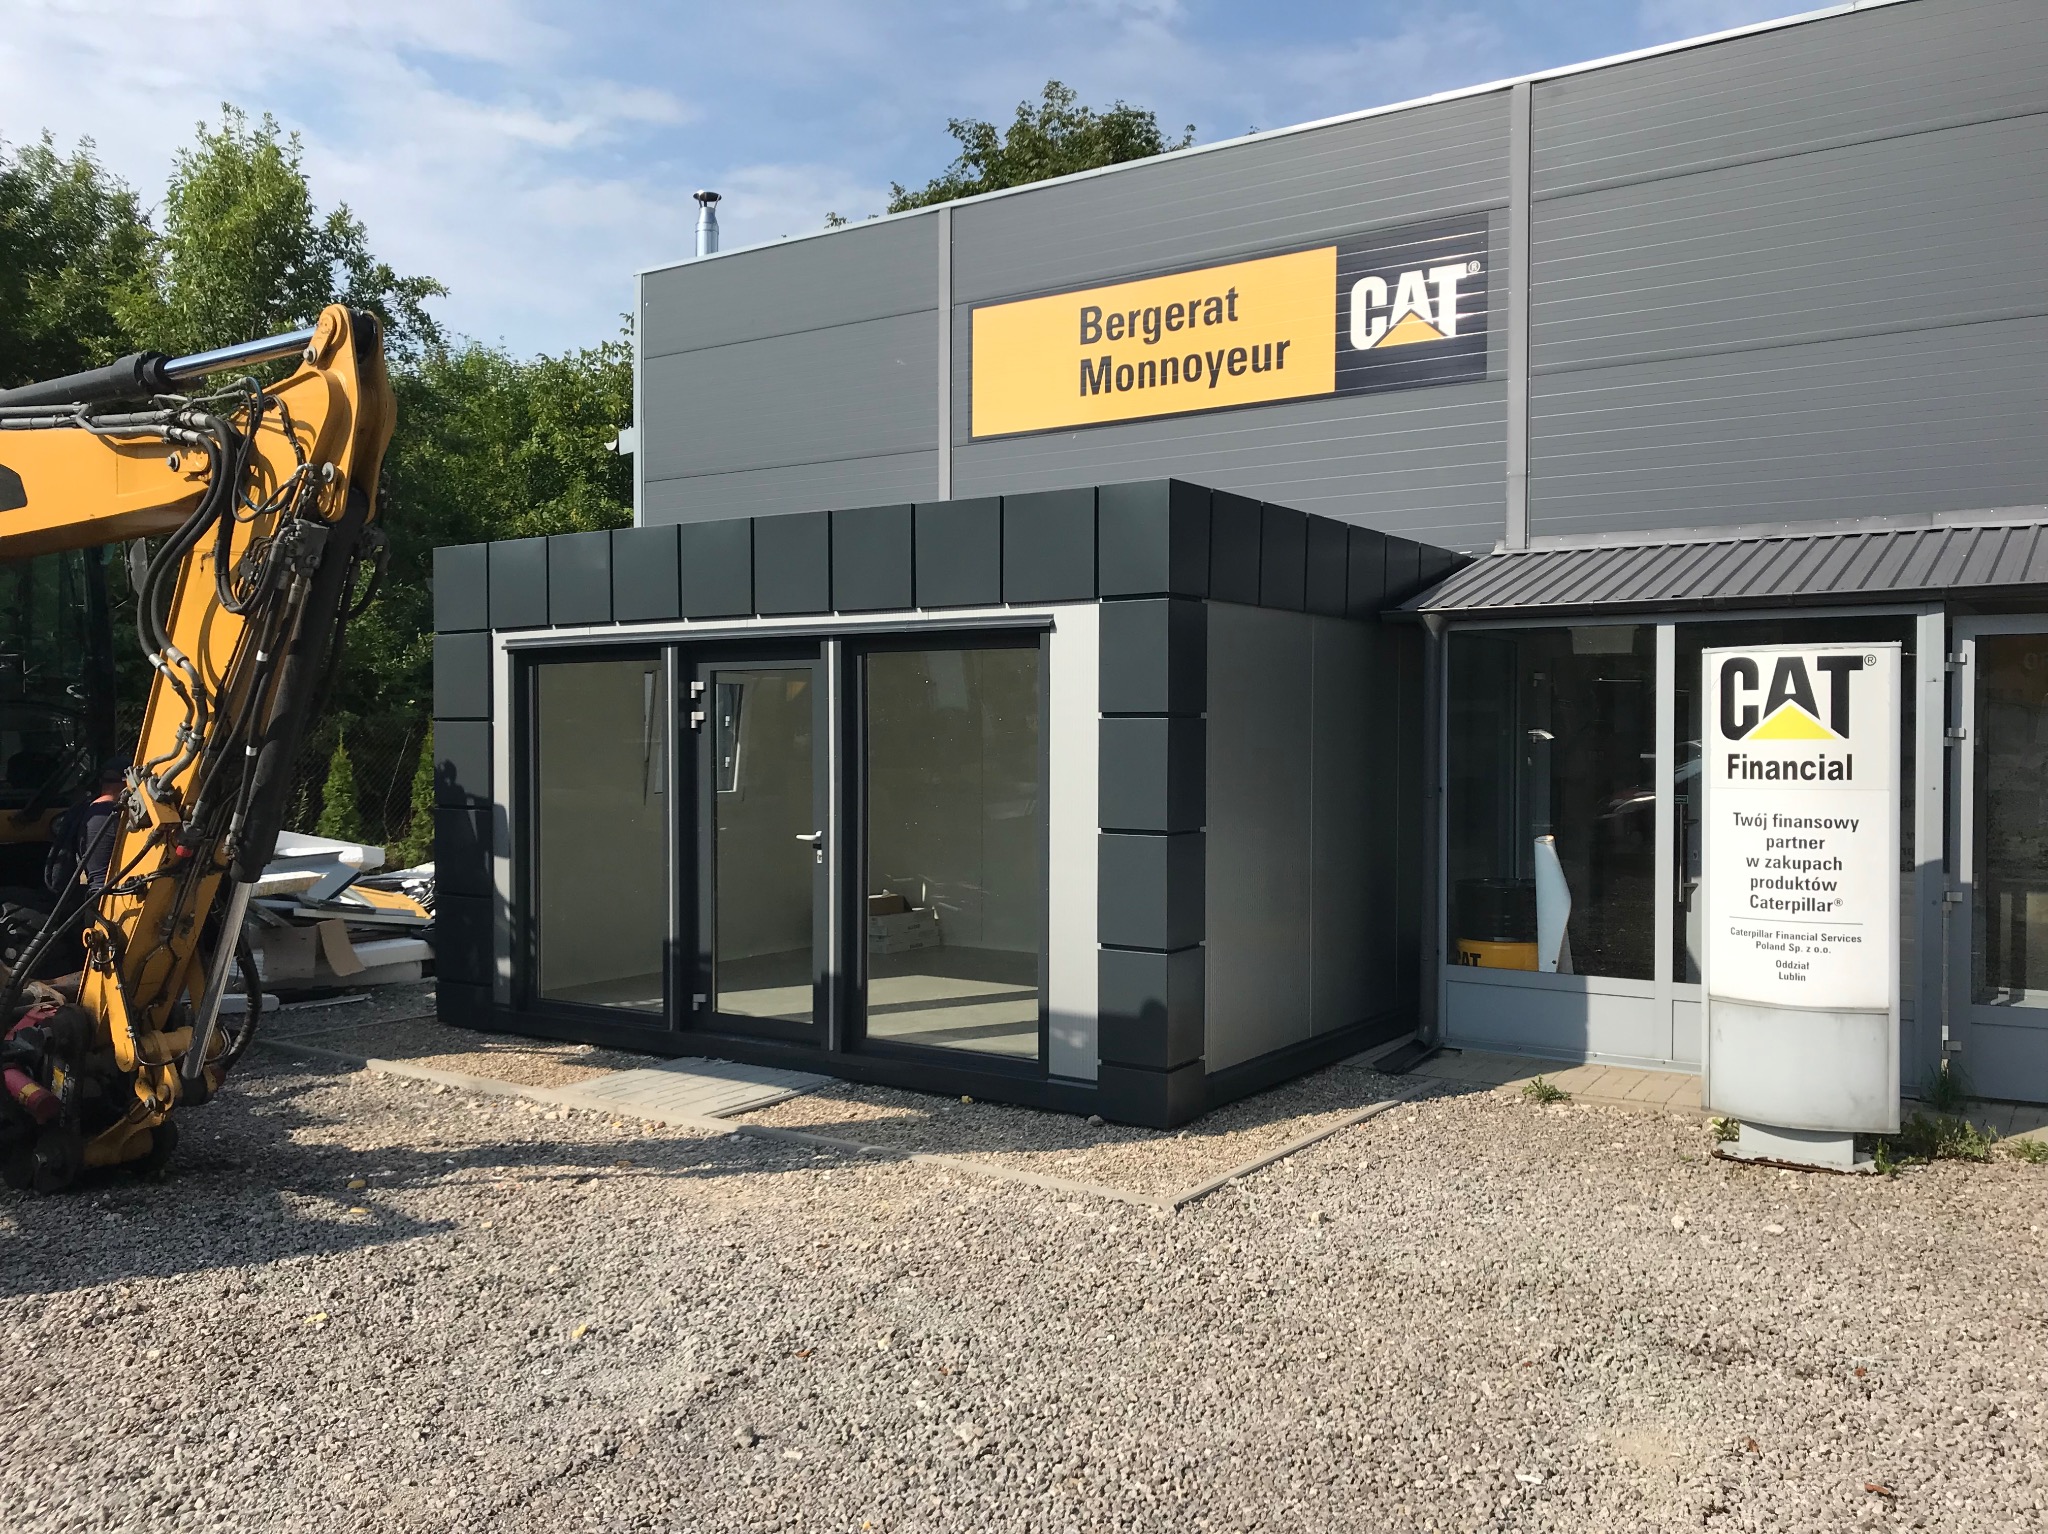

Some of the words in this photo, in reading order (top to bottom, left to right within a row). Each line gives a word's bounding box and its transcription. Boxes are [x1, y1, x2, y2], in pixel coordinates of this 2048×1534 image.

[1079, 286, 1239, 346] Bergerat
[1079, 339, 1291, 398] Monnoyeur
[1727, 753, 1853, 781] Financial
[1733, 812, 1768, 831] Twój
[1772, 813, 1860, 833] finansowy
[1766, 836, 1826, 851] partner
[1746, 857, 1760, 868] w
[1764, 855, 1843, 873] zakupach
[1750, 875, 1838, 892] produktów
[1730, 926, 1773, 939] Caterpillar
[1775, 930, 1818, 942] Financial
[1820, 932, 1863, 944] Services
[1755, 940, 1786, 952] Poland
[1788, 943, 1804, 954] Sp.
[1813, 946, 1832, 955] o.o.
[1775, 959, 1810, 970] Oddział
[1778, 971, 1807, 982] Lublin
